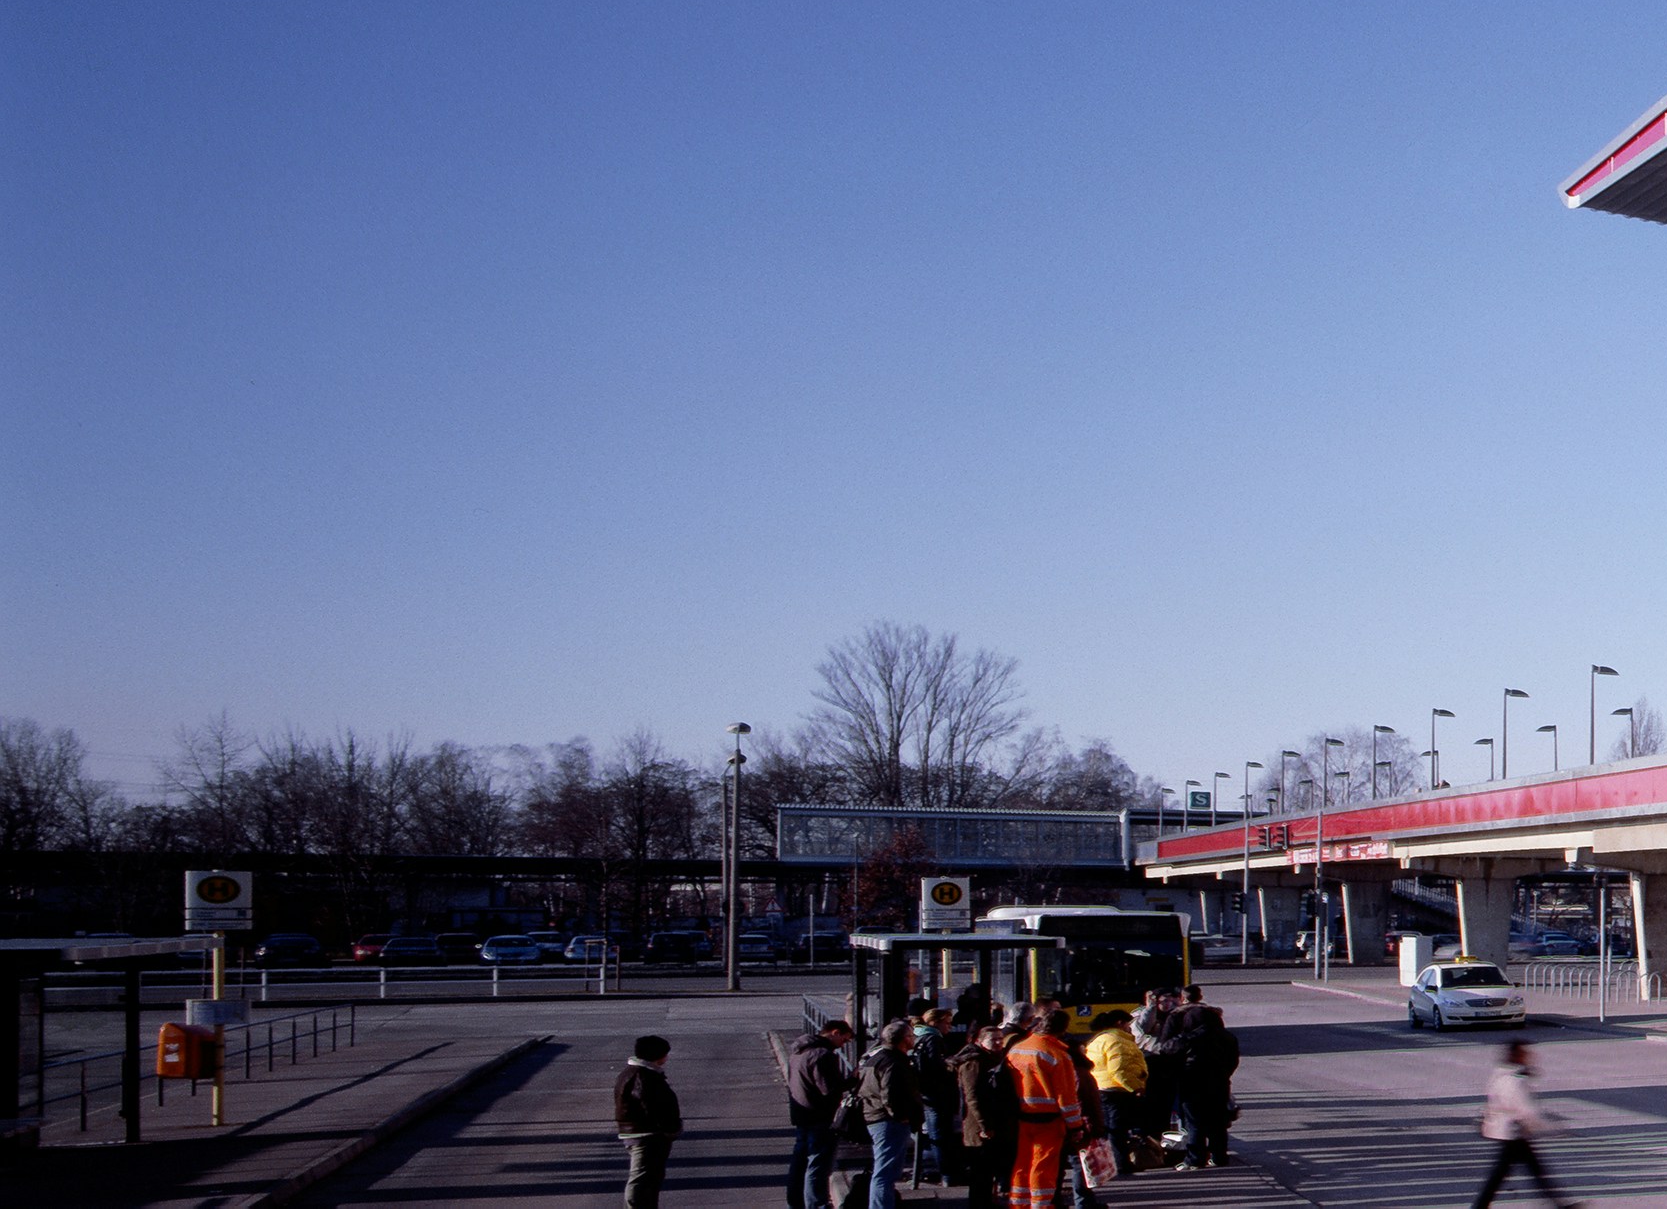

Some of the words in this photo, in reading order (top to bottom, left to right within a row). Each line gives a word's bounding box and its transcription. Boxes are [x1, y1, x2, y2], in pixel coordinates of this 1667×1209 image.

[1194, 793, 1208, 806] S
[207, 882, 230, 898] H
[939, 887, 955, 900] H
